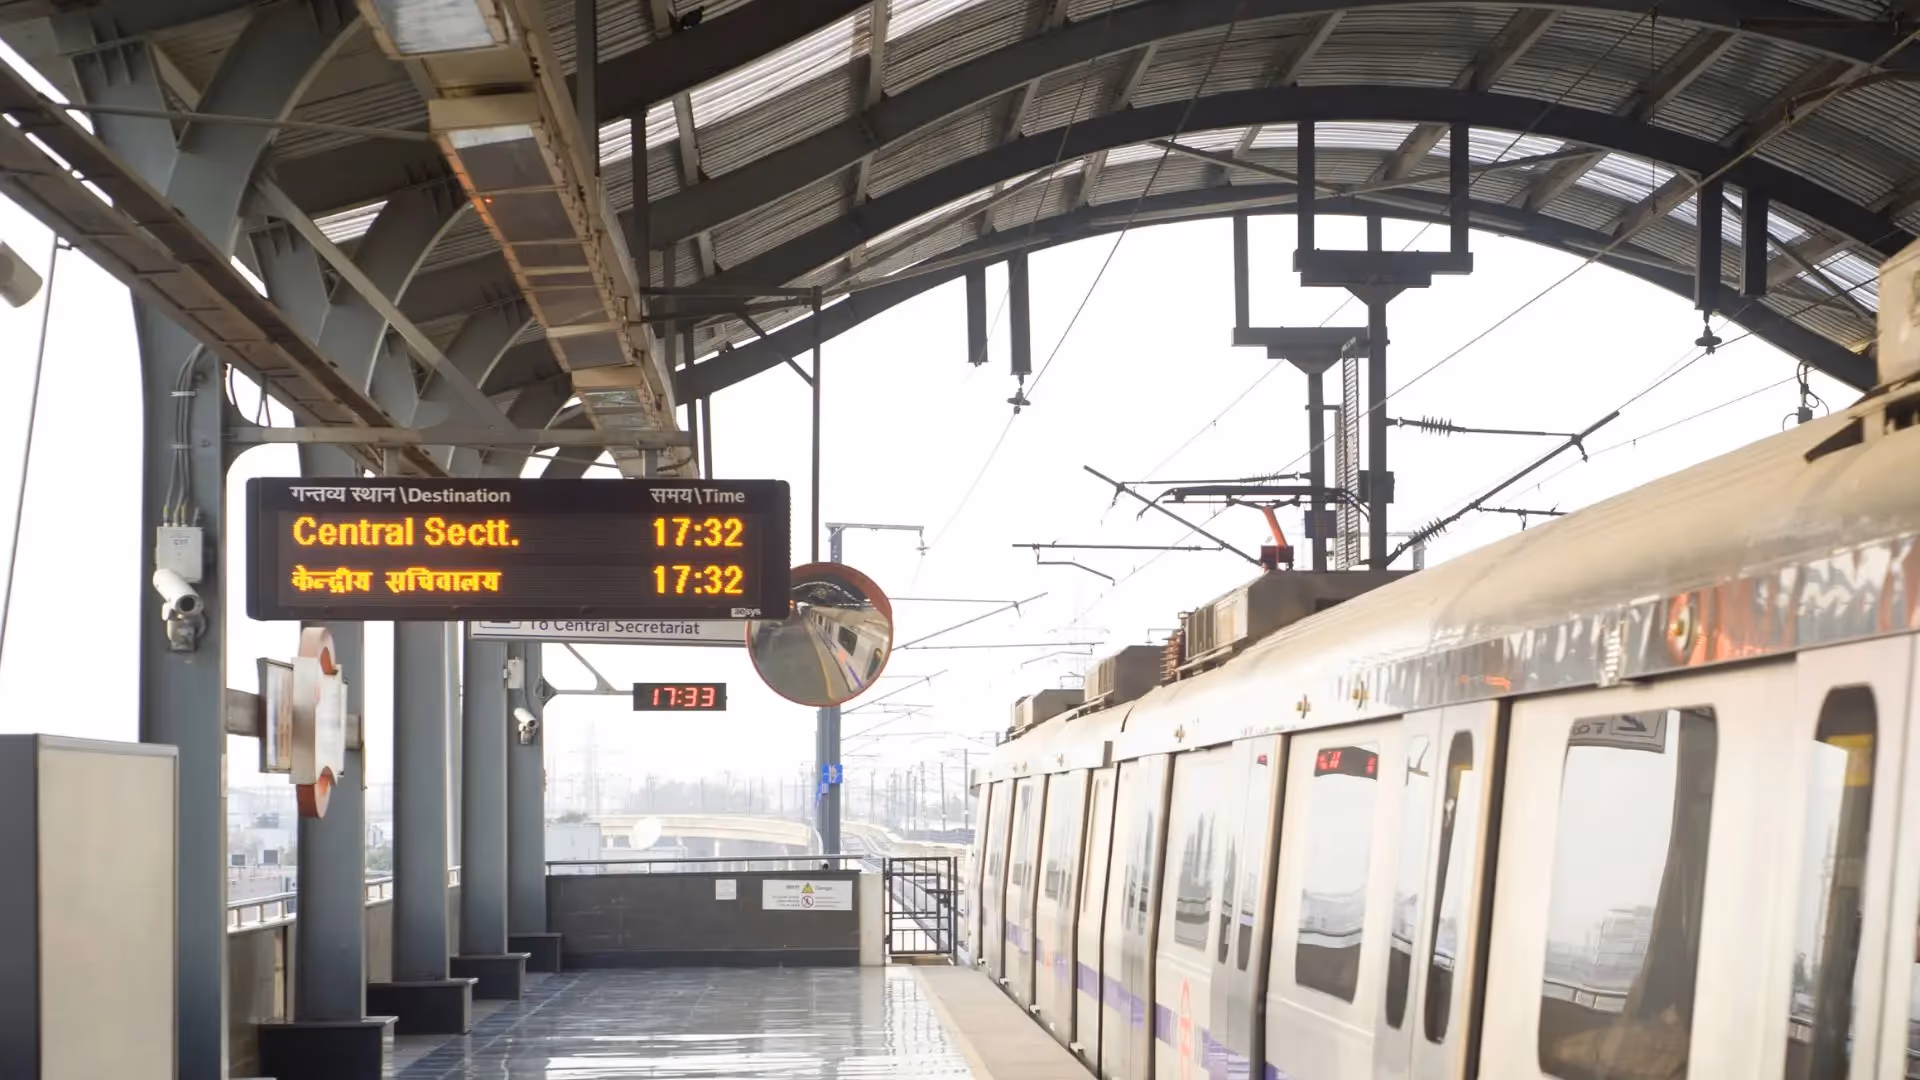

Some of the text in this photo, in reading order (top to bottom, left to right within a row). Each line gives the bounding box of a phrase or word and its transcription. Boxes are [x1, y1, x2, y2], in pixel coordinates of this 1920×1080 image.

[290, 486, 346, 502] गन्तव्य
[352, 486, 396, 502] स्थान
[293, 516, 520, 546] Central Sectt.
[653, 518, 744, 547] 17:32
[291, 565, 502, 593] केन्द्रीय सचिवालय
[653, 565, 744, 594] 17:32
[529, 619, 700, 635] To Central Secretariat
[652, 687, 715, 707] 17:33
